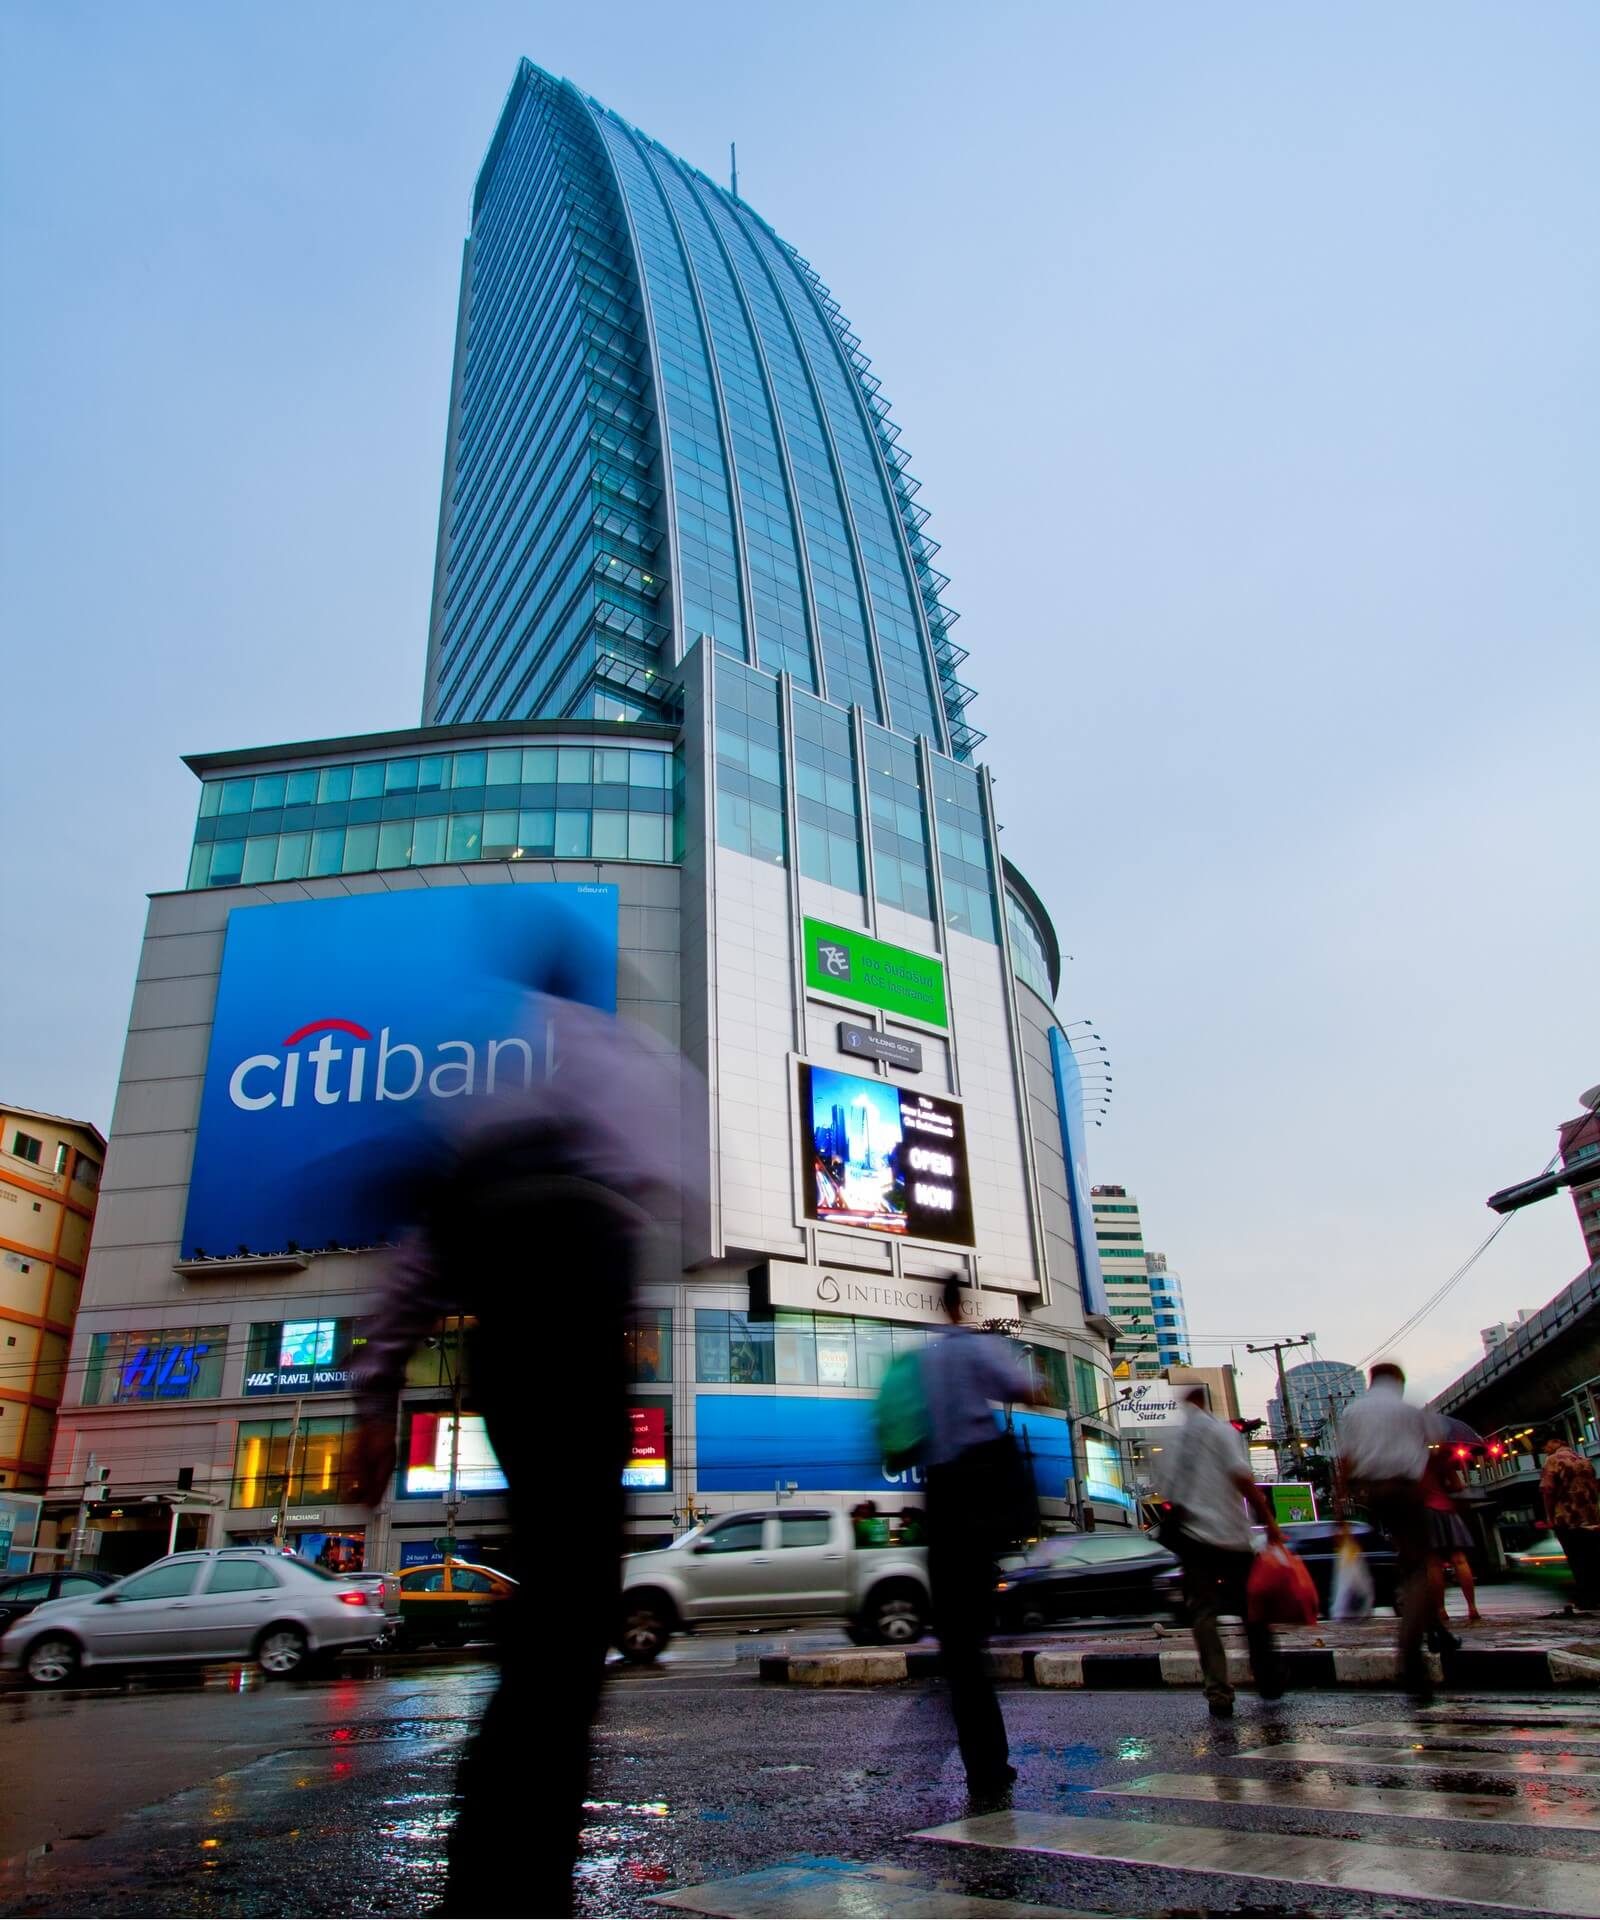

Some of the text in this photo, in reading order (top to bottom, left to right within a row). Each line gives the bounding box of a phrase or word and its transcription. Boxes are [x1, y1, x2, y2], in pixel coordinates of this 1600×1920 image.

[908, 1146, 955, 1177] OPEN
[914, 1182, 955, 1211] NOW
[847, 1283, 984, 1318] INTERCHAGE
[1137, 1411, 1167, 1421] Suites
